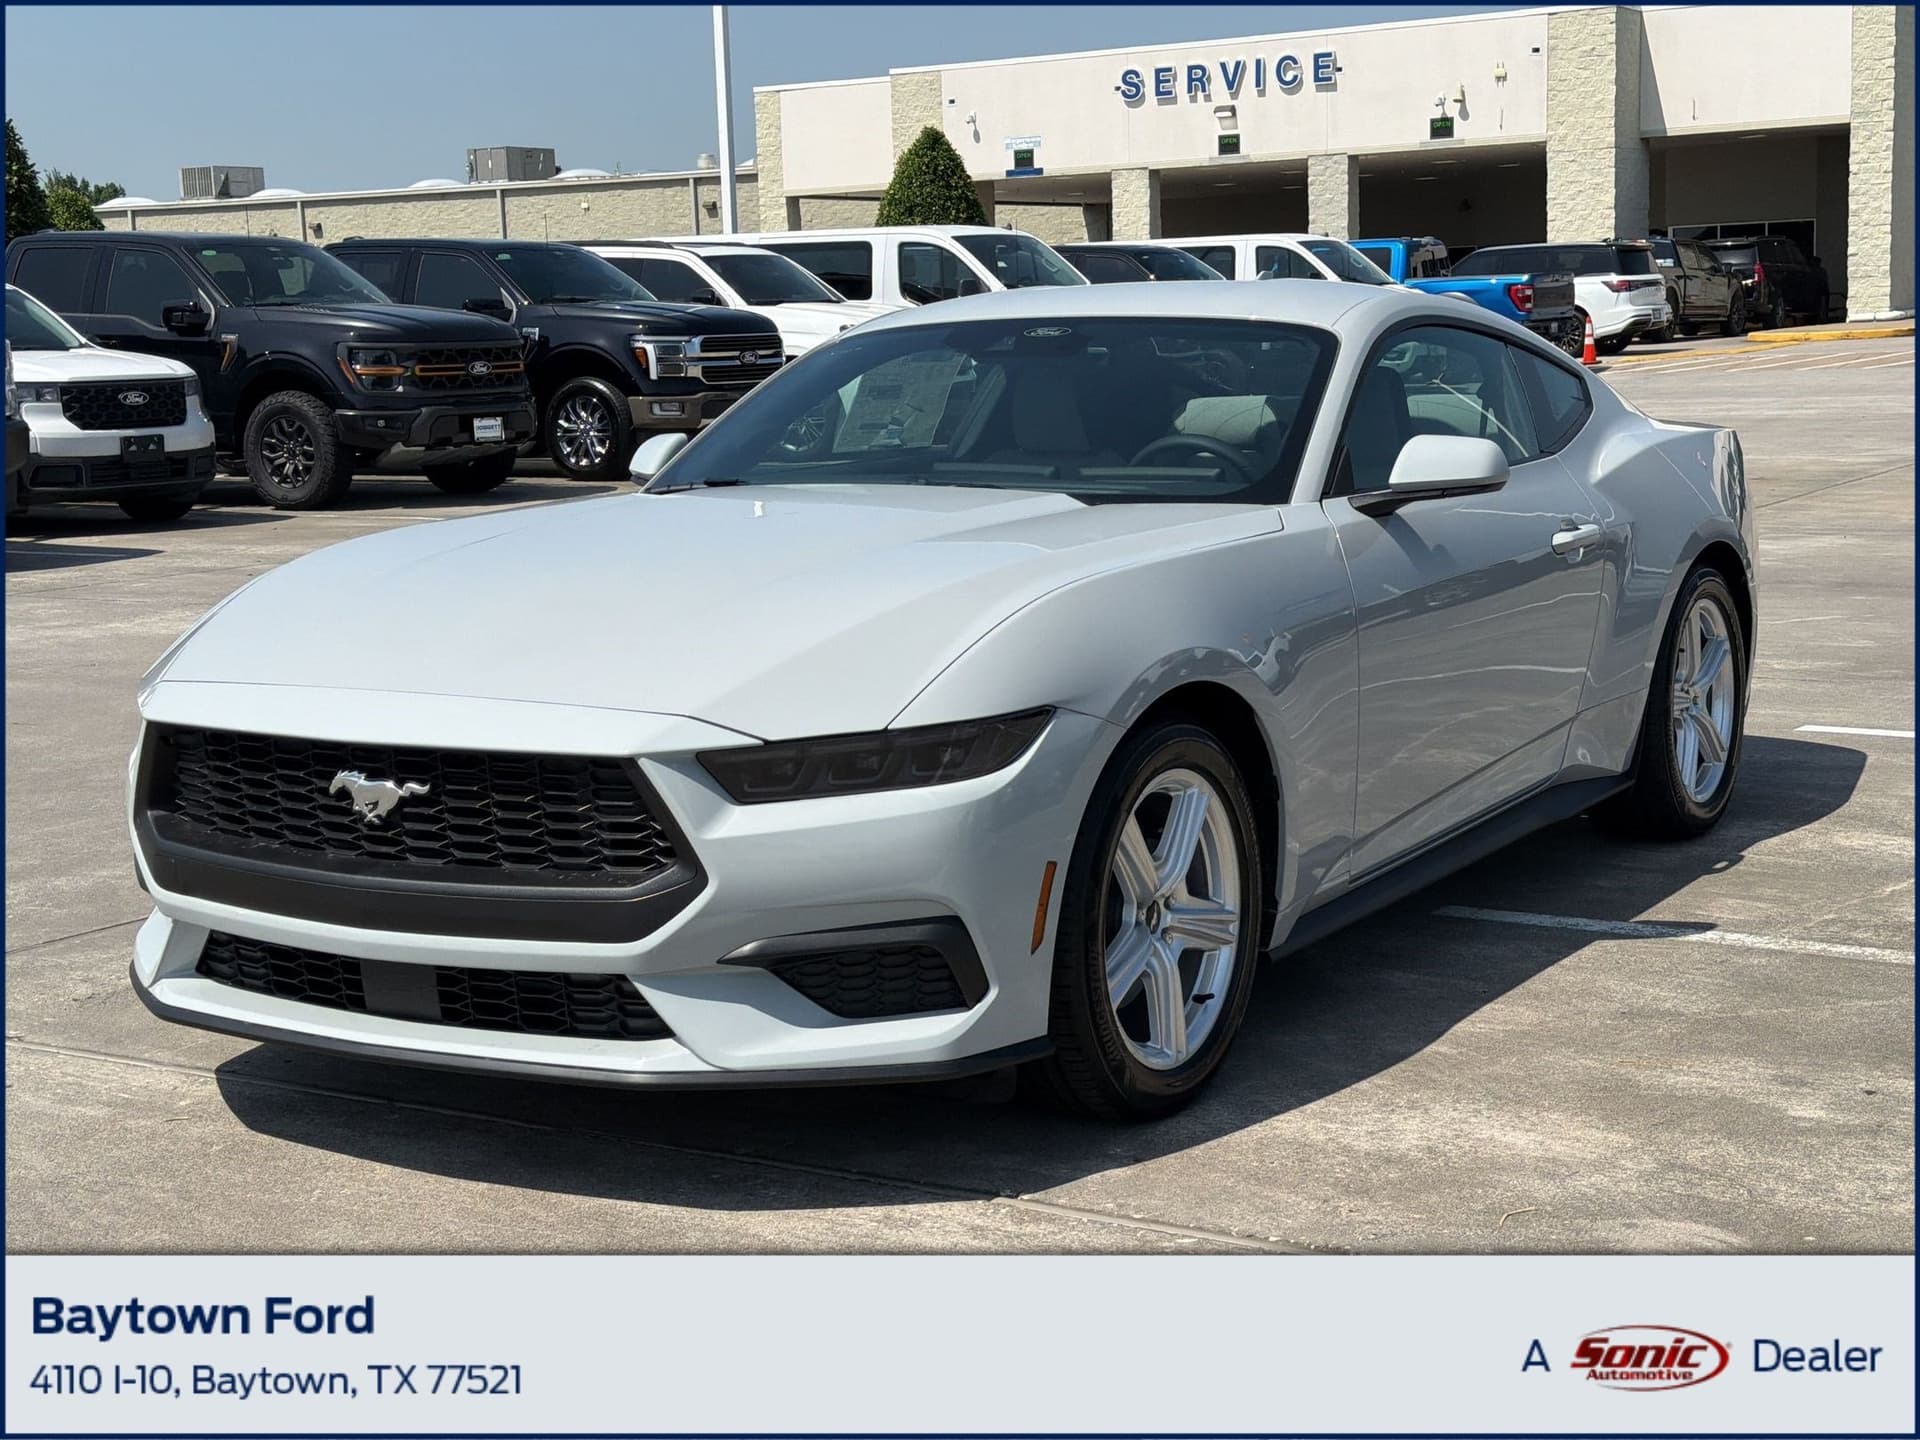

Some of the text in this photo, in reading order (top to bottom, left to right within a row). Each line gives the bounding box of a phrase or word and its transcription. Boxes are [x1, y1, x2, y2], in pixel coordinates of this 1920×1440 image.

[1121, 51, 1333, 100] SERVICE
[1432, 120, 1451, 129] OPEN
[1221, 136, 1238, 145] OPEN
[1015, 151, 1032, 160] OPEN
